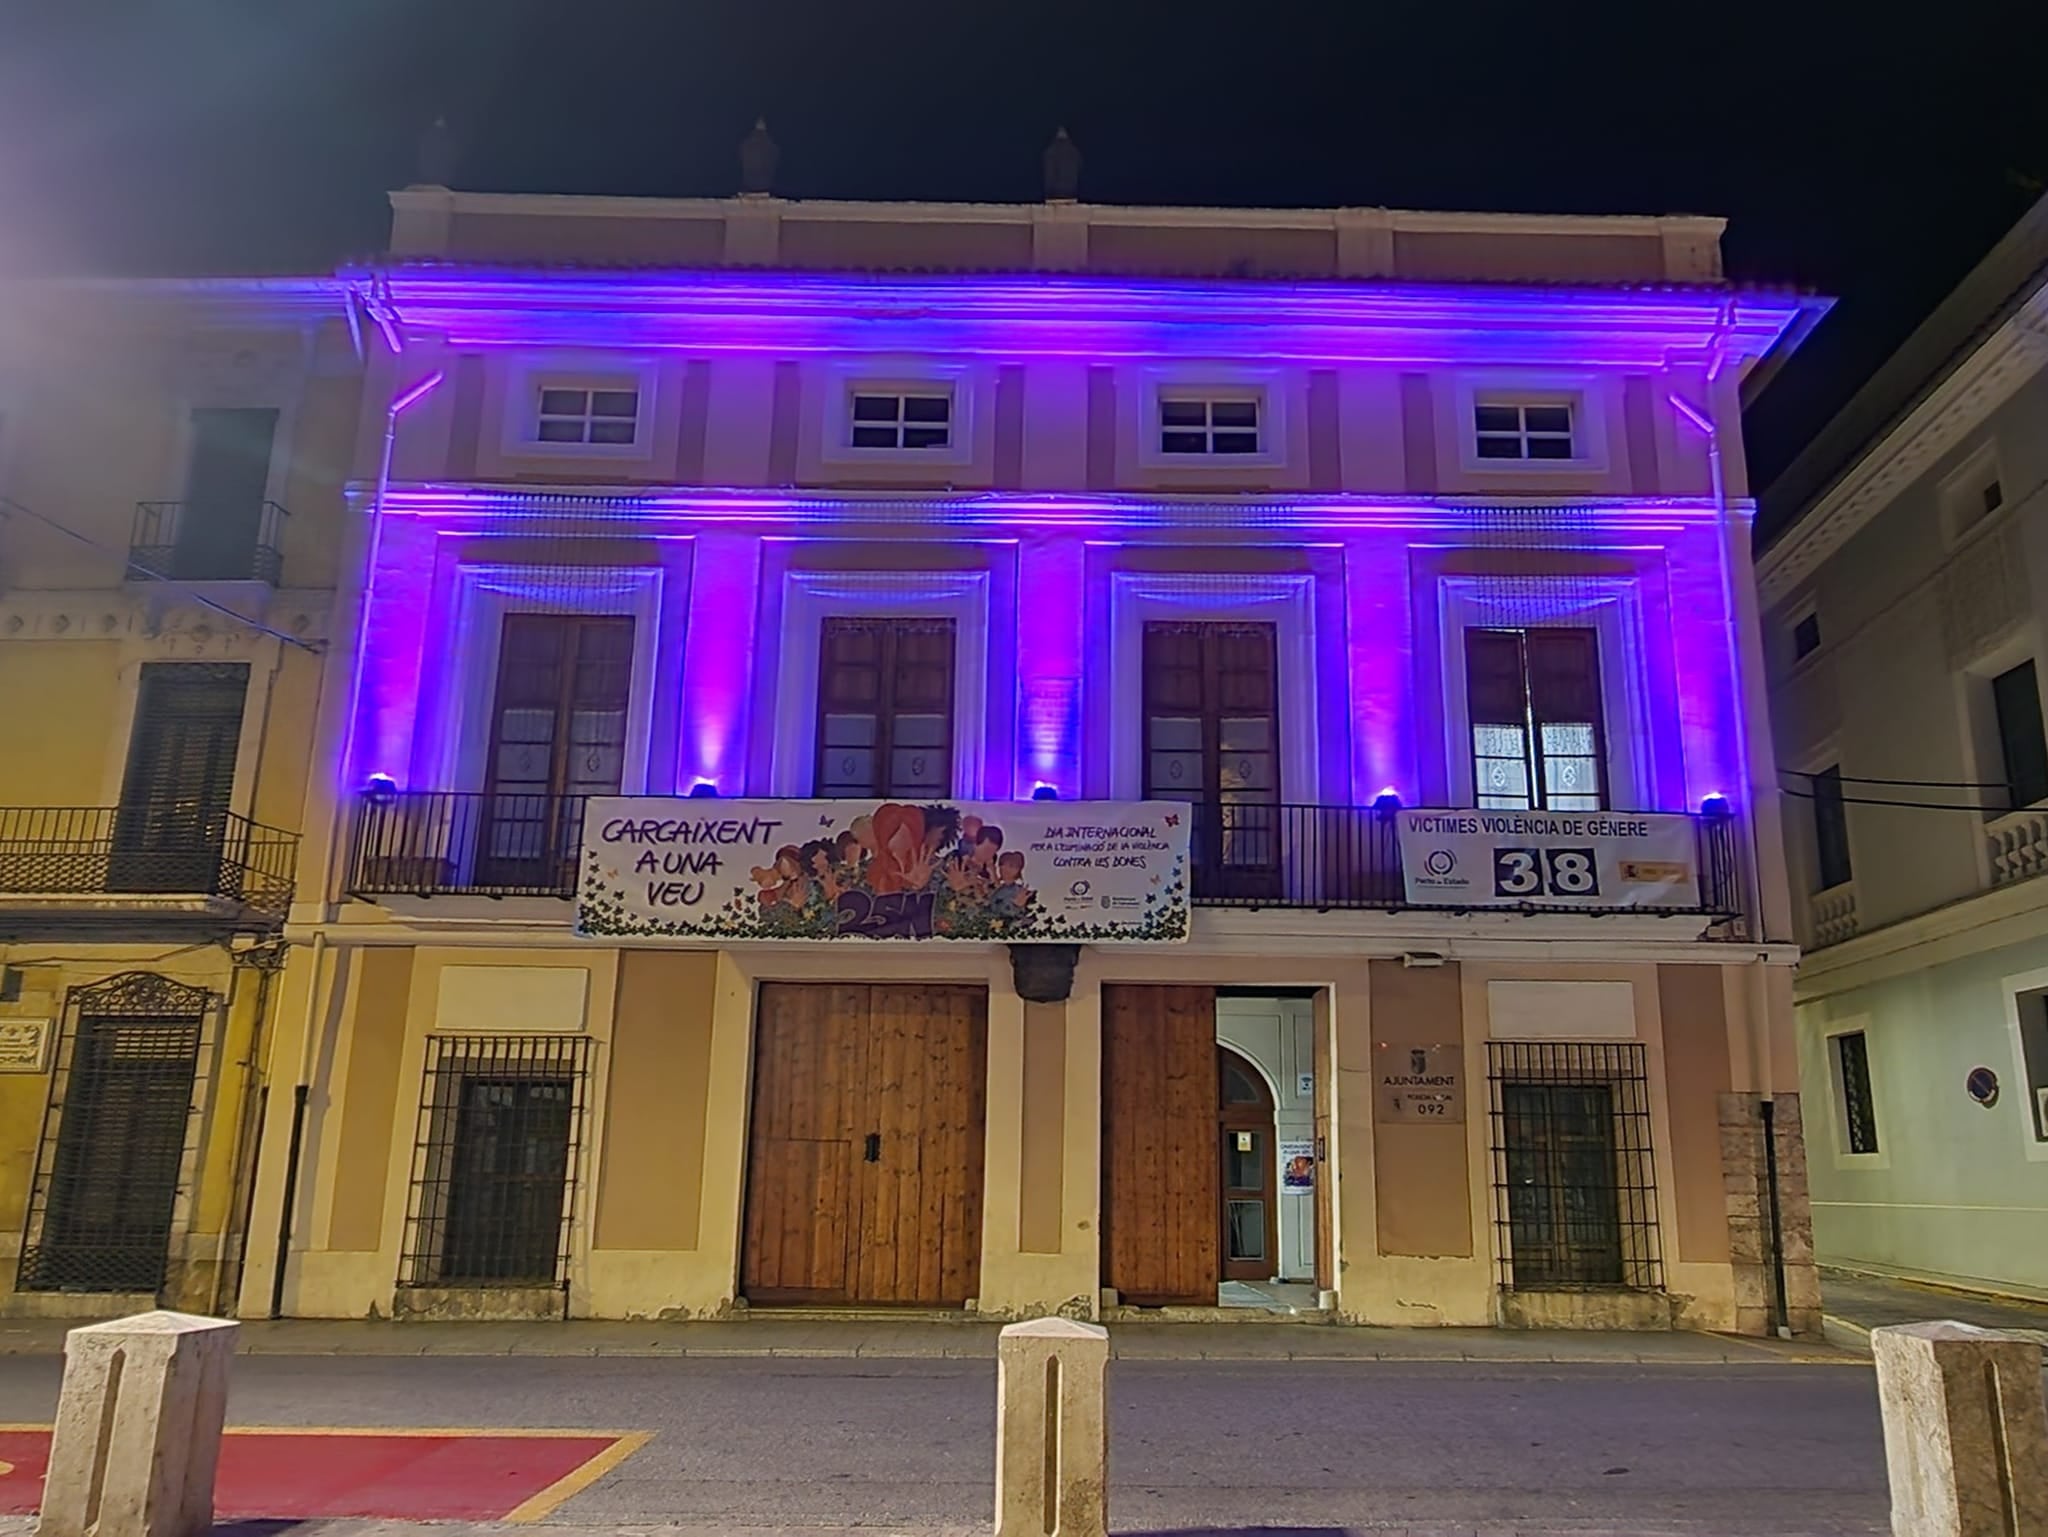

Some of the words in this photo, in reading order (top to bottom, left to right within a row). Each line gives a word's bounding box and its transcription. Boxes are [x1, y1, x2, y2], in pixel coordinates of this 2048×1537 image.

[602, 817, 782, 845] CARCAIXENT
[1044, 826, 1064, 839] DIA
[1065, 826, 1156, 839] INTERNACIONAL
[1408, 816, 1478, 834] VICTIMES
[1481, 814, 1560, 835] VIOLÈNCIA
[1562, 820, 1583, 836] DE
[1587, 816, 1648, 837] GÈNERE
[635, 849, 660, 874] A
[663, 851, 723, 876] UNA
[1053, 857, 1091, 867] CONTRA
[1094, 856, 1110, 868] LES
[1112, 855, 1147, 869] DONES
[1499, 852, 1594, 893] 38
[648, 881, 705, 906] VEU
[1383, 1076, 1455, 1086] AJUNTAMENT
[1418, 1104, 1445, 1115] 092
